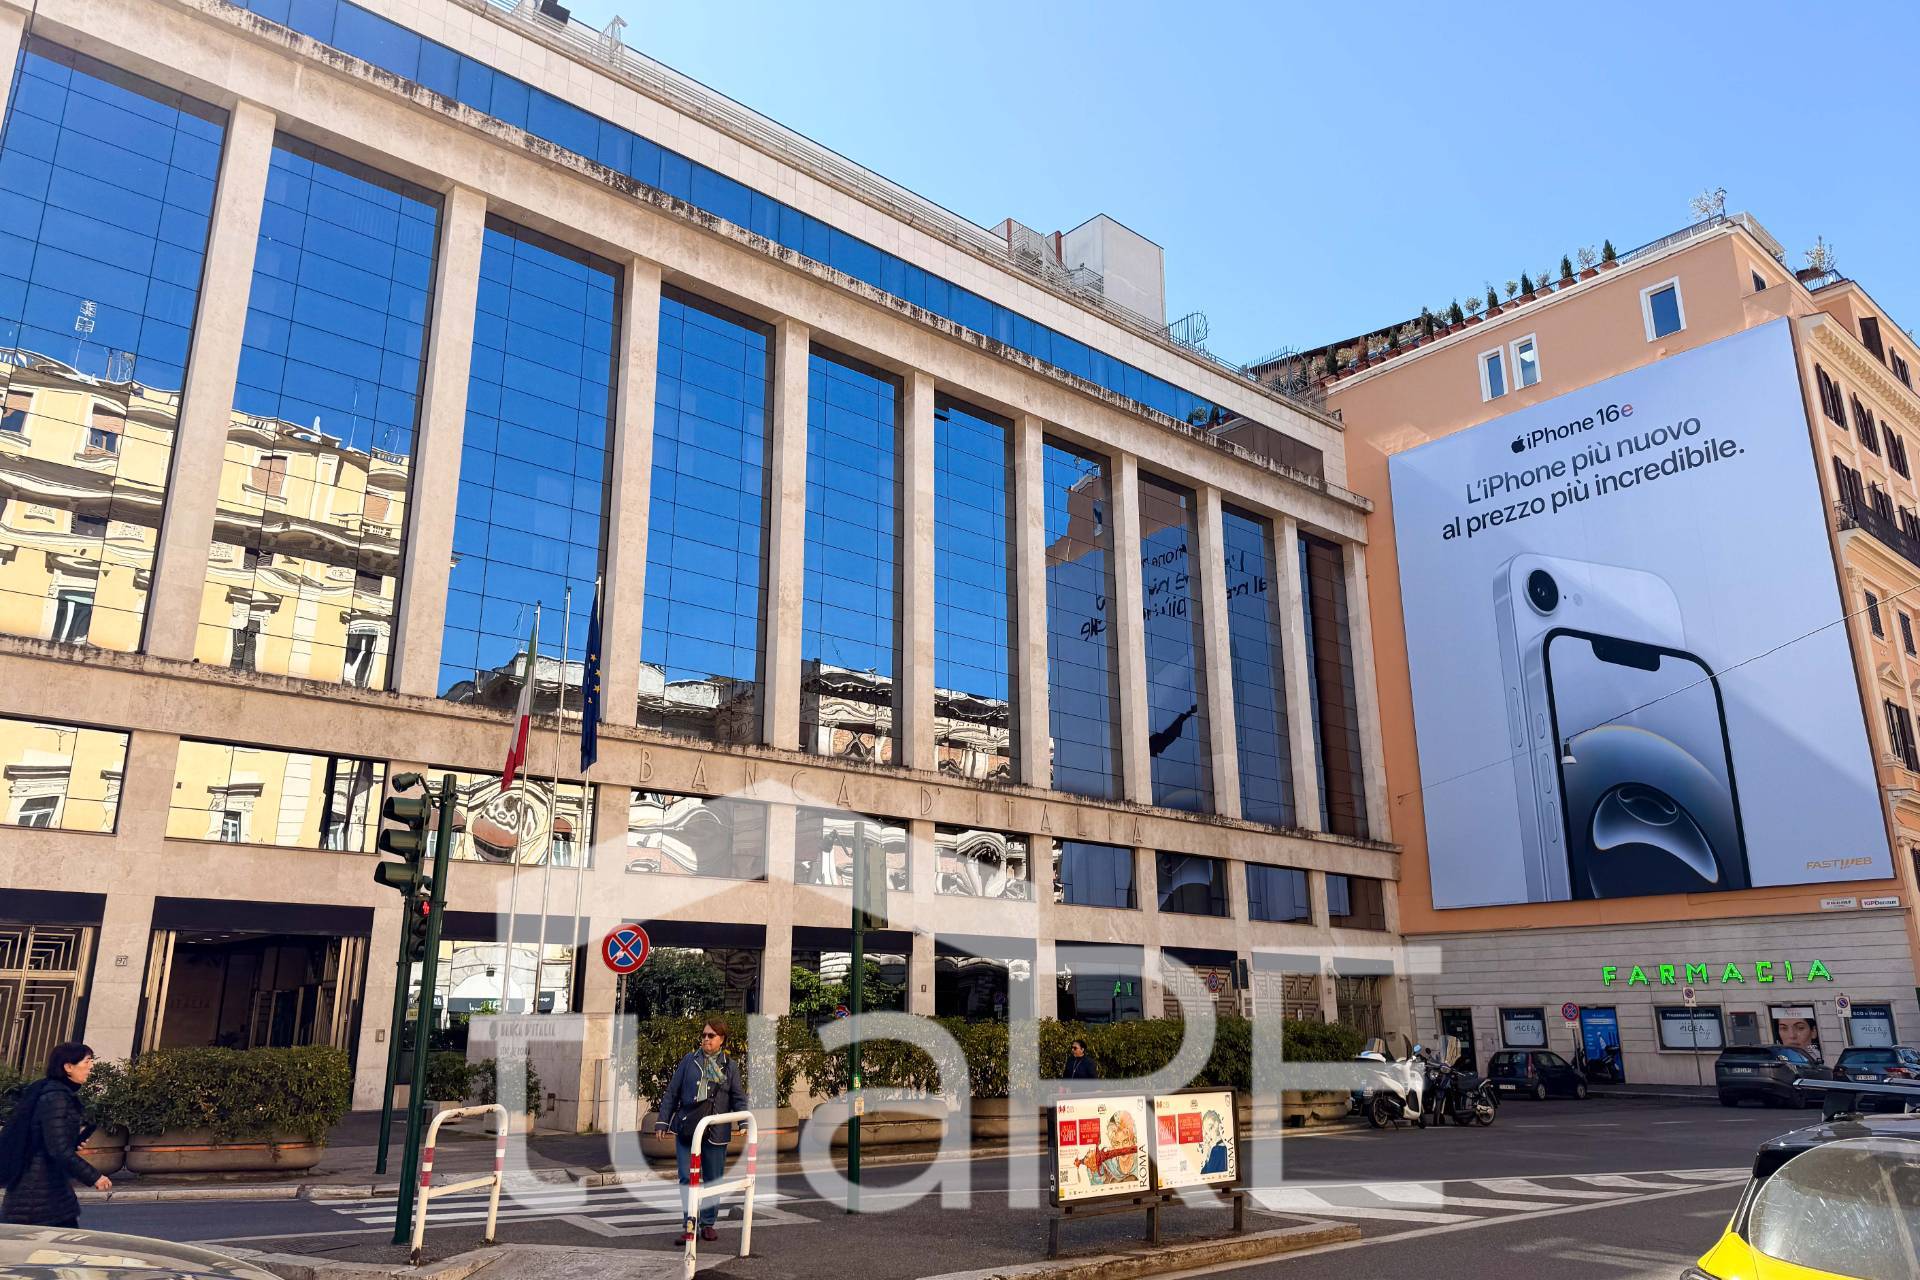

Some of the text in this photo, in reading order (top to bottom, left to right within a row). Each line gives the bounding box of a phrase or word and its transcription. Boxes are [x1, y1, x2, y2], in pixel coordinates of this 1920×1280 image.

[1526, 403, 1635, 450] iPhone 16e
[1571, 441, 1612, 477] più
[1616, 417, 1702, 458] nuovo
[1442, 437, 1745, 541] al prezzo più incredibile.
[638, 747, 853, 810] BANCA
[1806, 856, 1873, 869] FASTWEB
[1602, 959, 1834, 986] FARMACIA
[1139, 1144, 1148, 1188] ROMA
